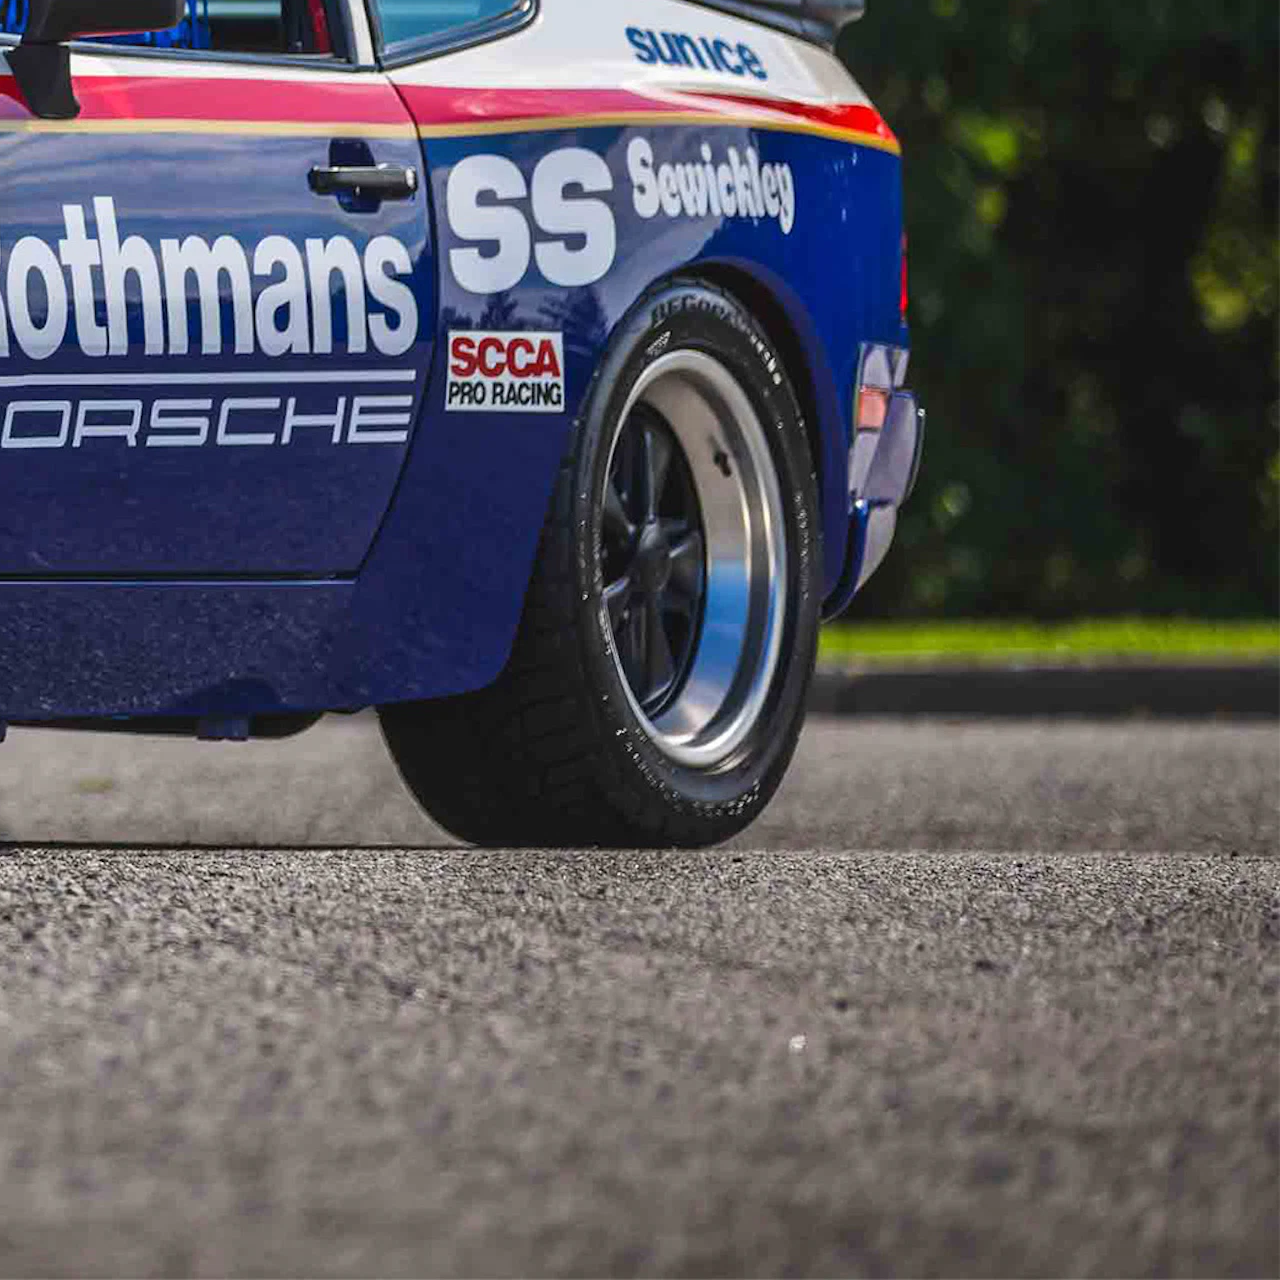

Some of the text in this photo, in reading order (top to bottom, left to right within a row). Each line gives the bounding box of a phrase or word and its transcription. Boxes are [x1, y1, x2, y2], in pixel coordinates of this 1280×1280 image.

[446, 148, 617, 294] SS
[627, 137, 796, 235] Sewickley
[450, 336, 561, 378] SCCA
[448, 381, 562, 406] PRO RACING
